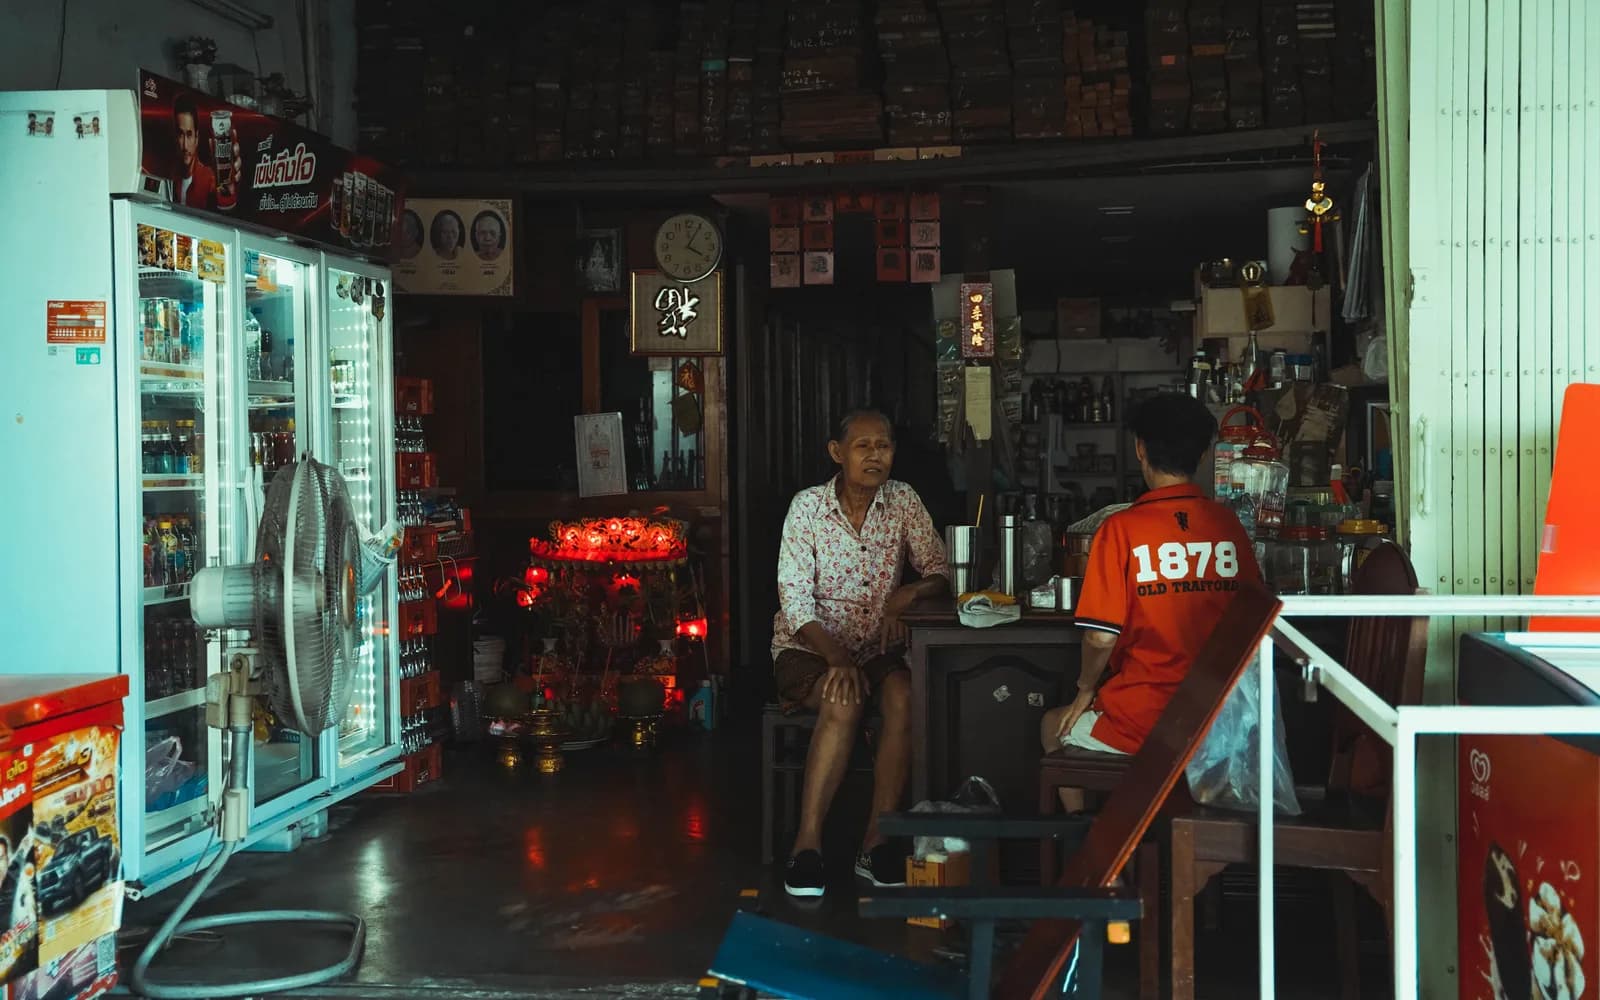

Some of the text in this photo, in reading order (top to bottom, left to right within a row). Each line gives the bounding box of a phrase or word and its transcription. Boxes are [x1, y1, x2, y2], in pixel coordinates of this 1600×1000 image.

[253, 143, 315, 188] เข้มถึงใจ
[1132, 541, 1238, 582] 1878
[1138, 580, 1239, 596] OLD TRAFFORD
